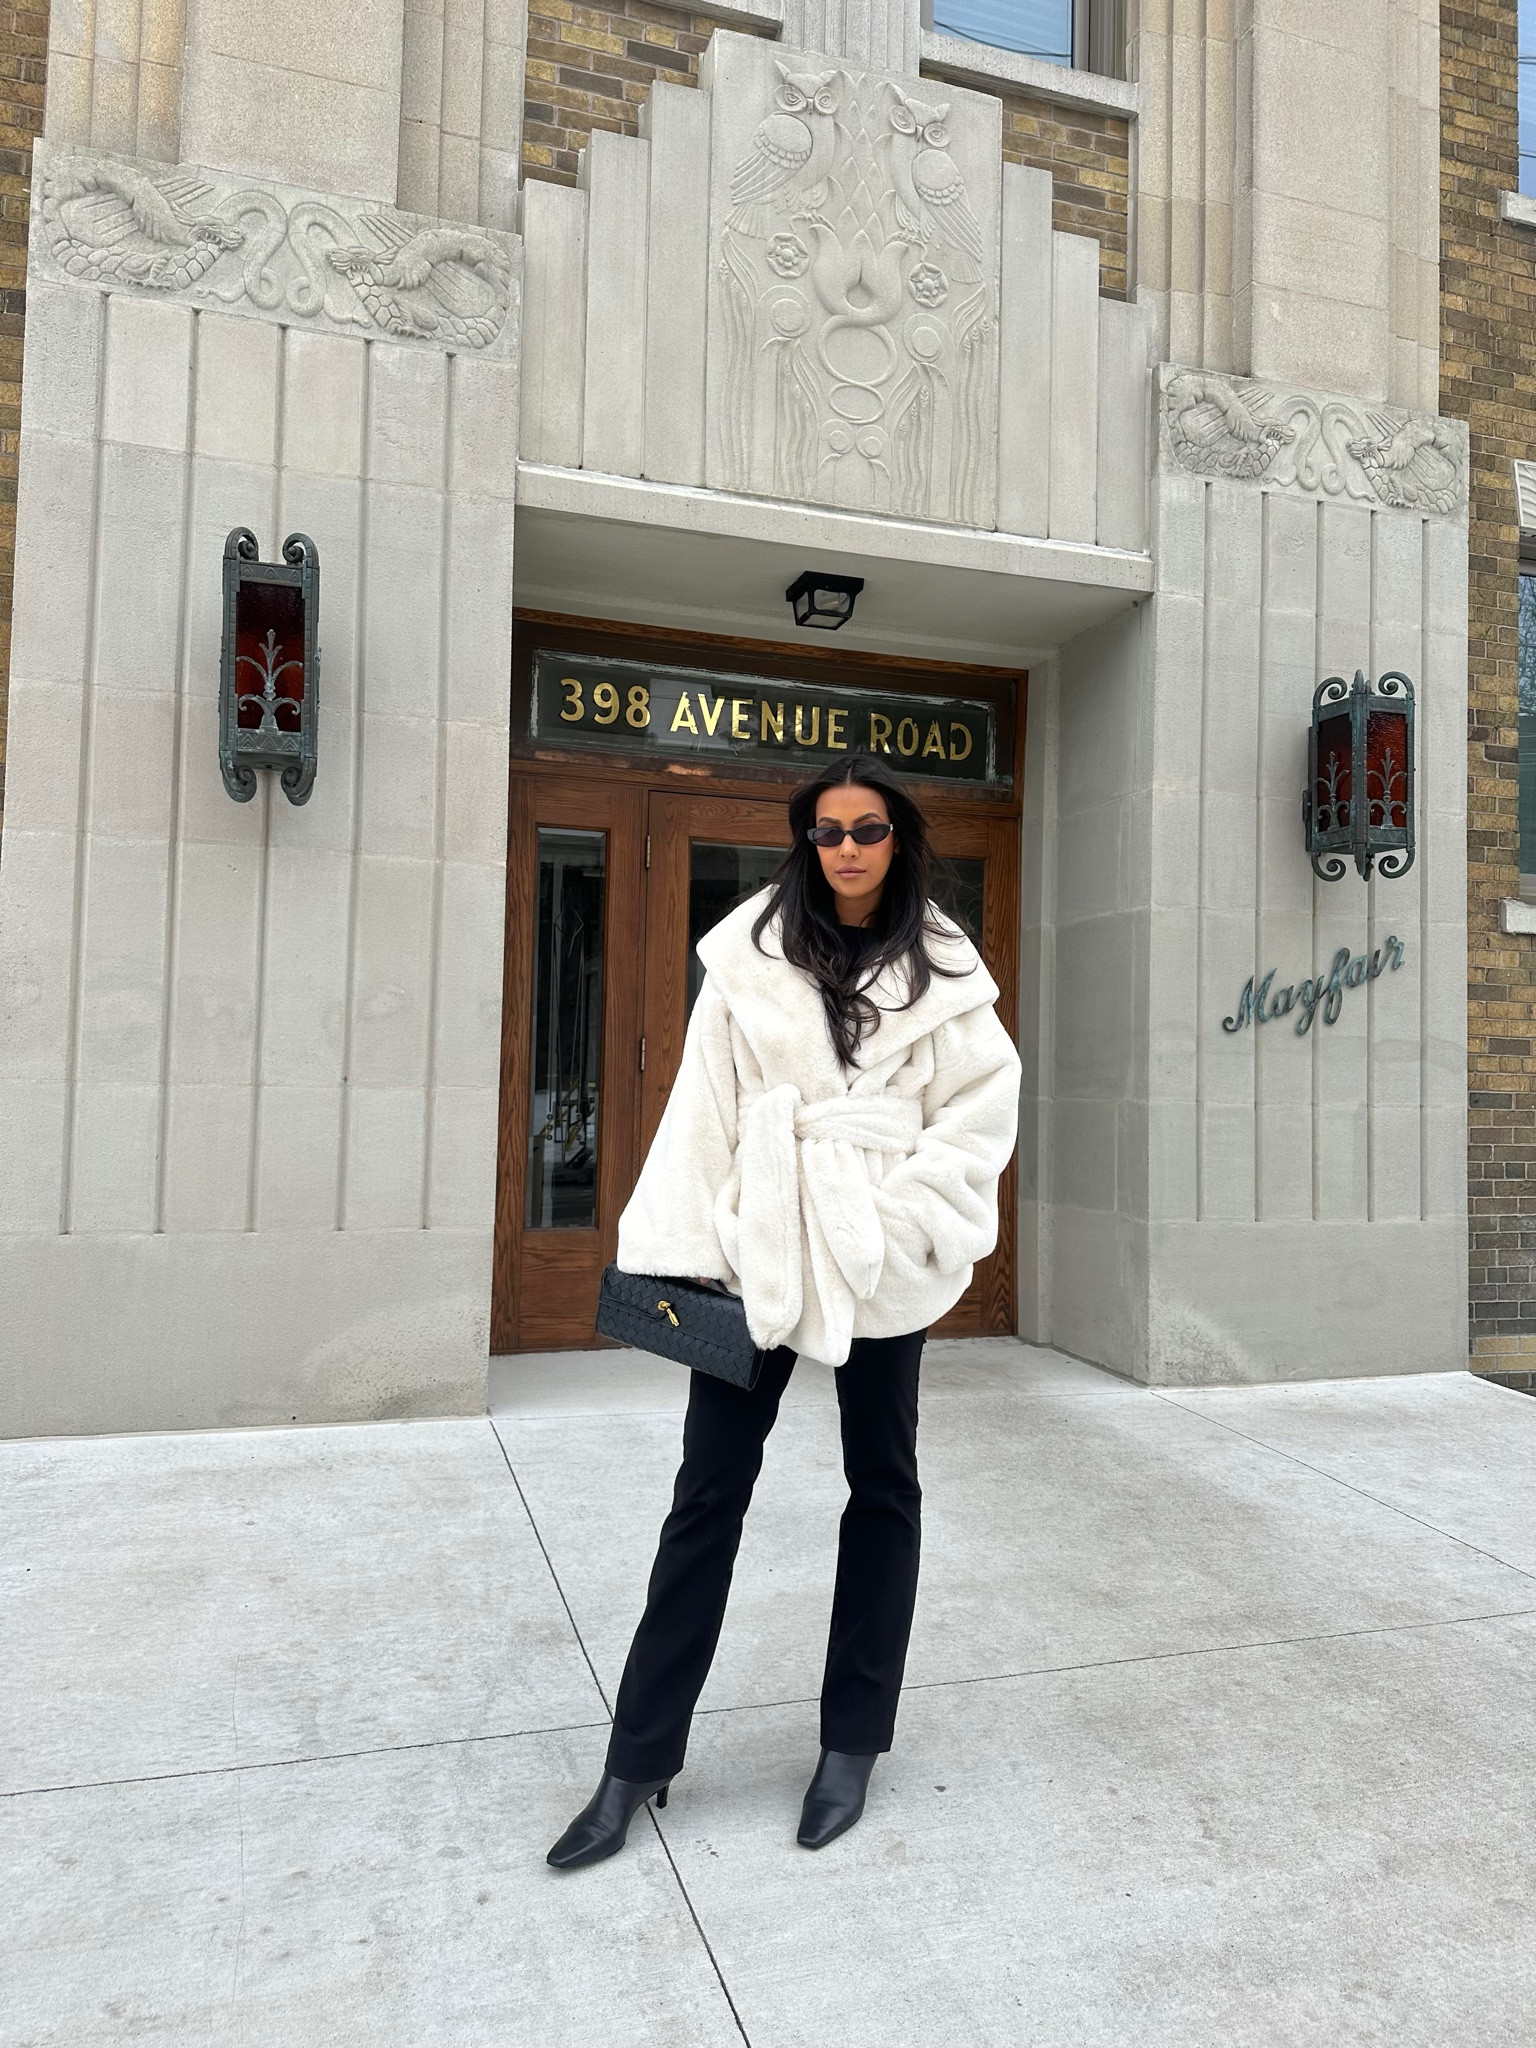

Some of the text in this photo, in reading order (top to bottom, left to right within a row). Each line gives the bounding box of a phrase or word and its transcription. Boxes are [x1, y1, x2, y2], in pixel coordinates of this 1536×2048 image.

[559, 677, 973, 762] 398 AVENUE ROAD
[1222, 935, 1406, 1036] Mayfair
